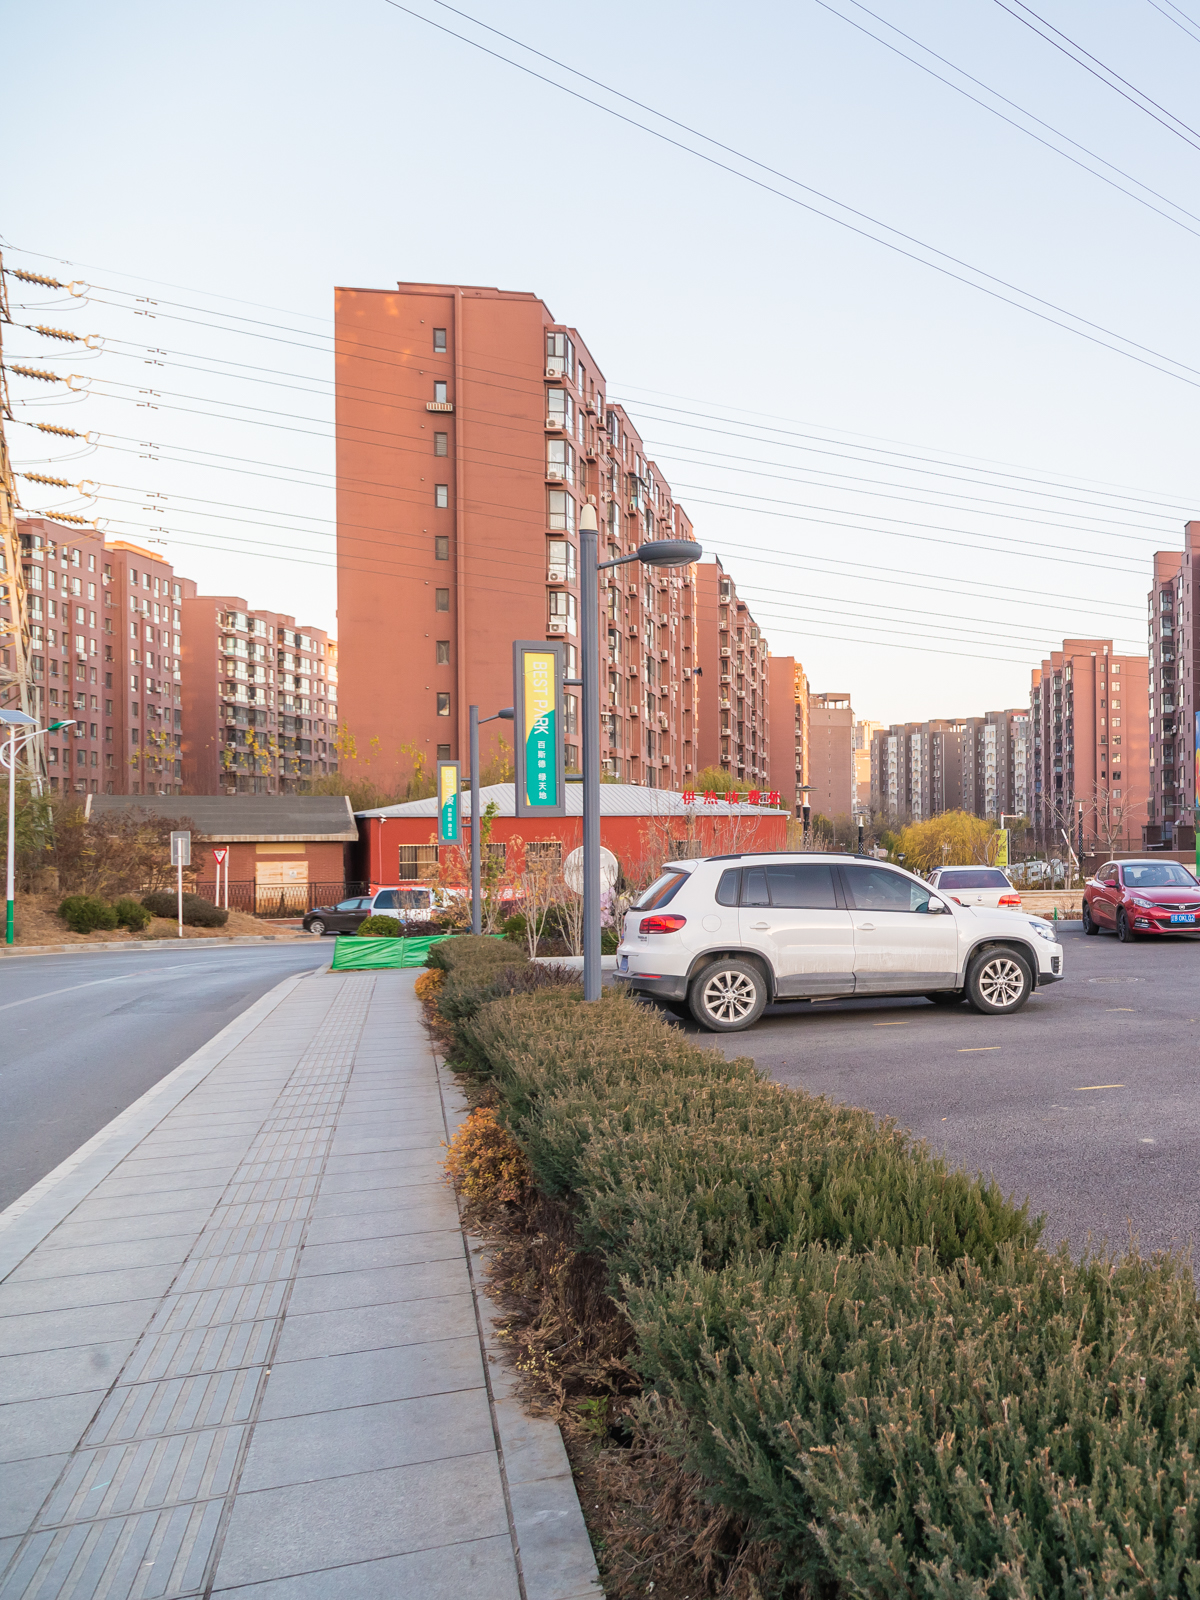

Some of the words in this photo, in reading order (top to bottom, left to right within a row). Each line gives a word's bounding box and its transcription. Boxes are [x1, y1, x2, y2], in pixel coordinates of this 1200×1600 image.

[532, 661, 548, 696] BEST
[533, 699, 549, 735] PARK
[682, 789, 781, 805] 供热收费处
